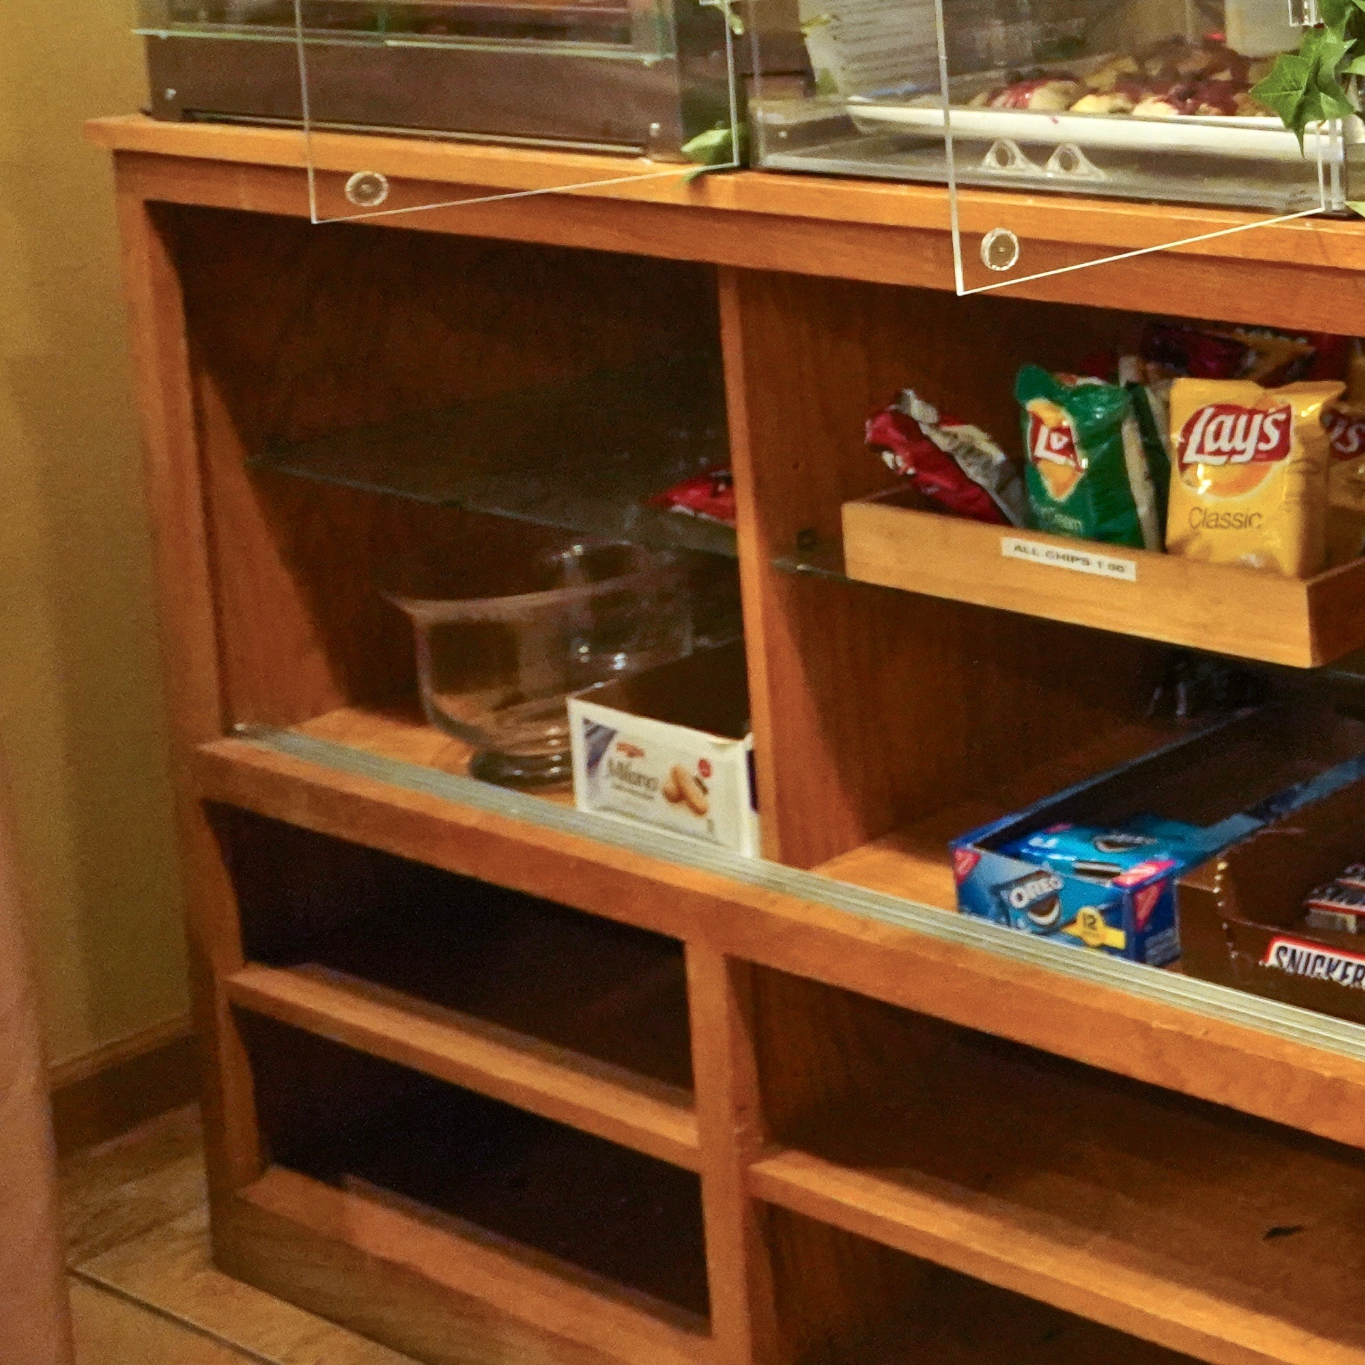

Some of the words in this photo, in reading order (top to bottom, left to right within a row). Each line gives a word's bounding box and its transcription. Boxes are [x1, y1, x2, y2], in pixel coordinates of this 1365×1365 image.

[1182, 406, 1288, 466] Lay's
[1188, 506, 1264, 531] Classic
[1009, 876, 1064, 910] OREO
[1082, 912, 1097, 931] 12
